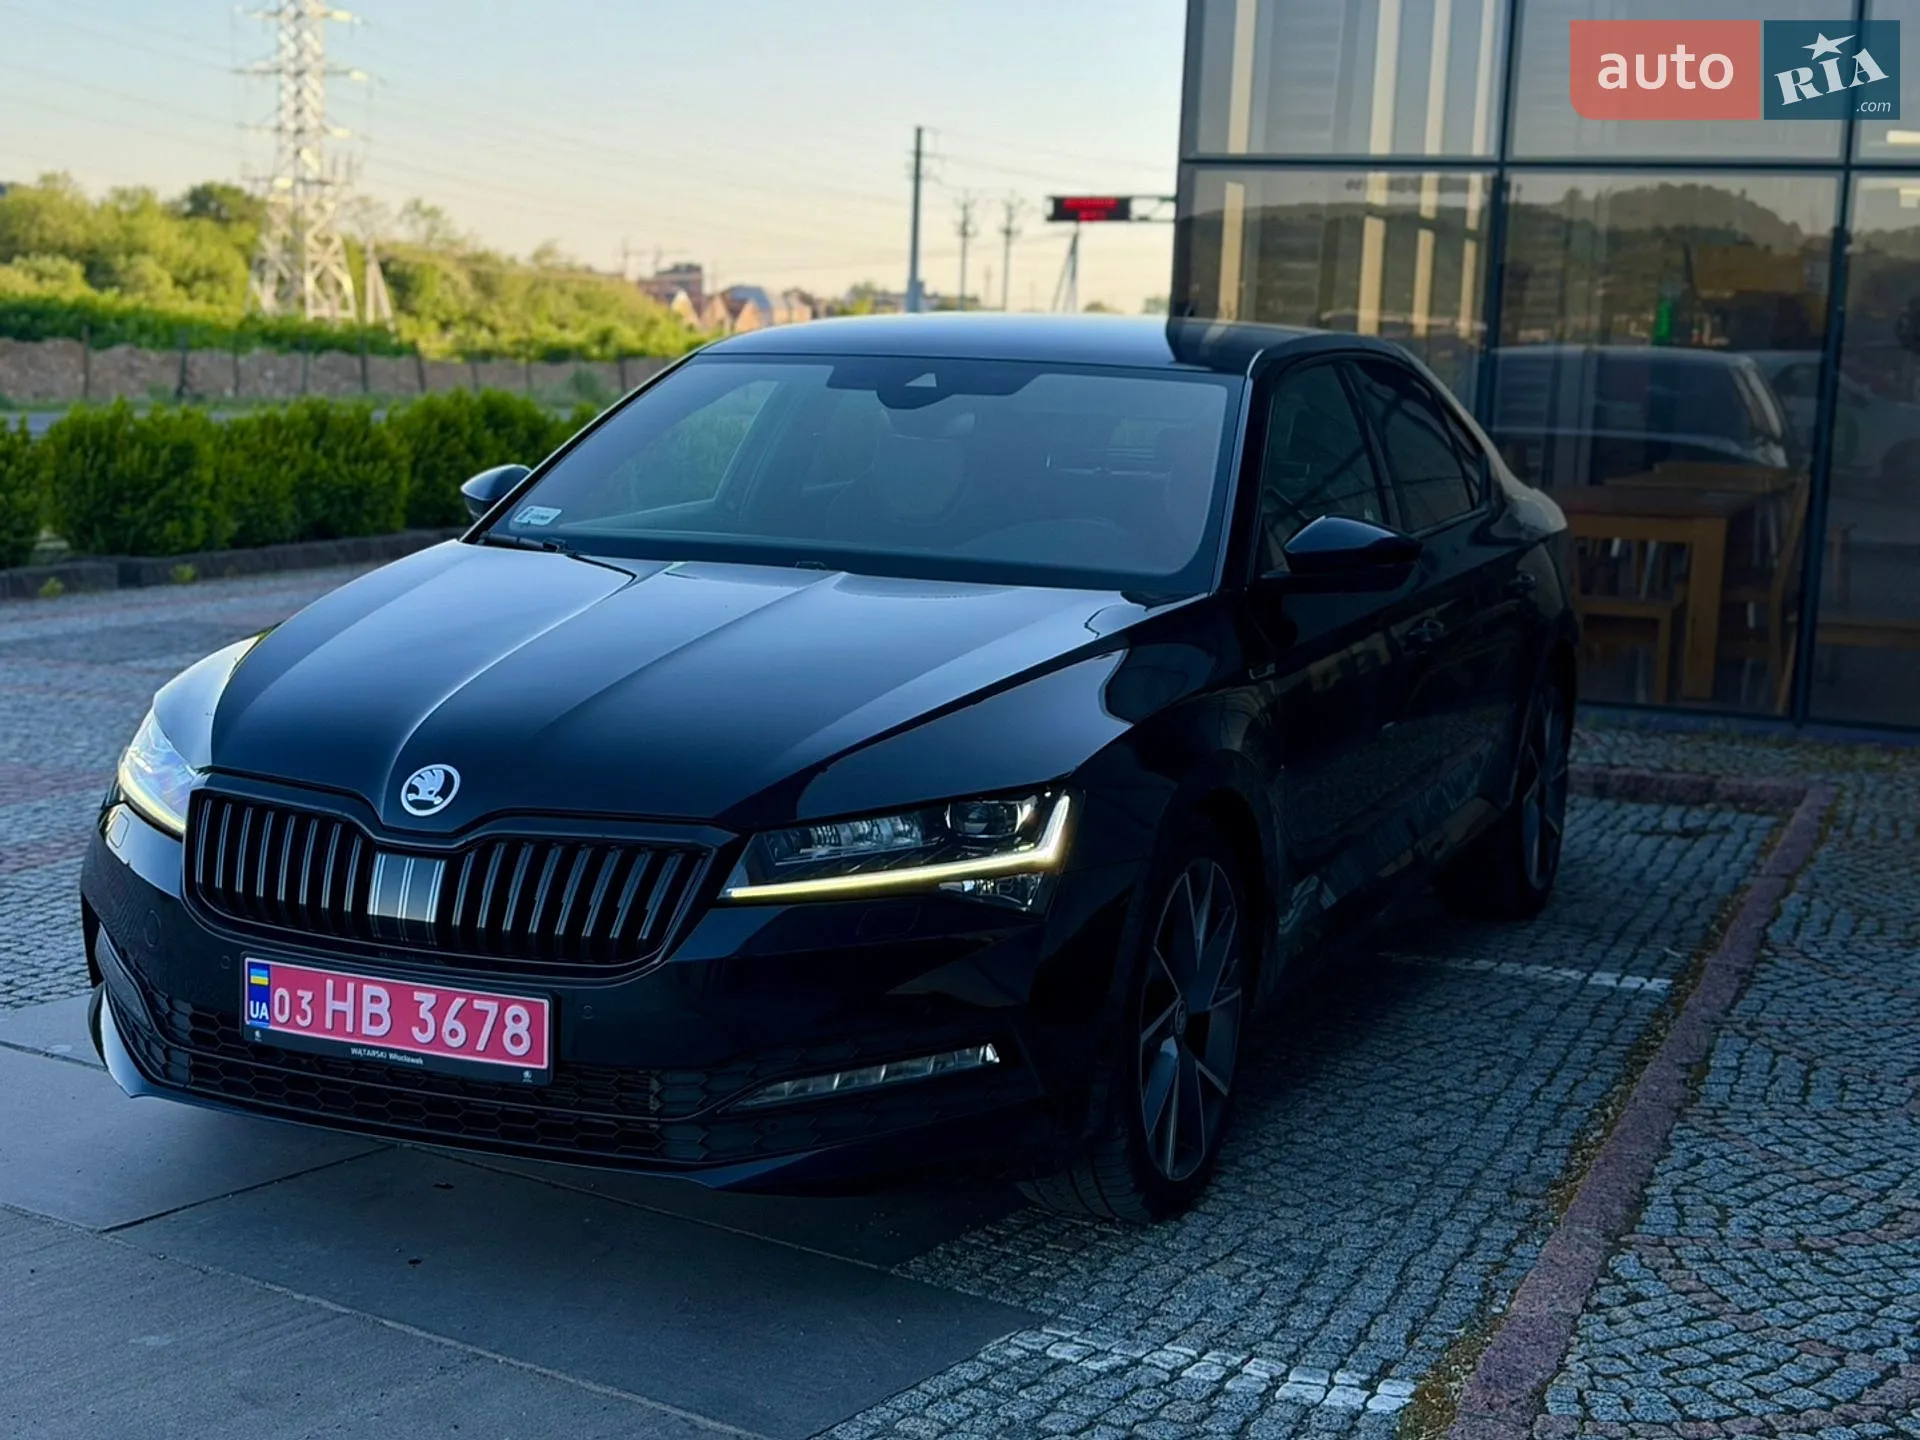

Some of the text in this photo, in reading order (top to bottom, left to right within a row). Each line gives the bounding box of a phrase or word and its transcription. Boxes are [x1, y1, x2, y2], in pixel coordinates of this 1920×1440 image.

[250, 1001, 269, 1020] UA
[273, 979, 532, 1056] 03 HB 3678
